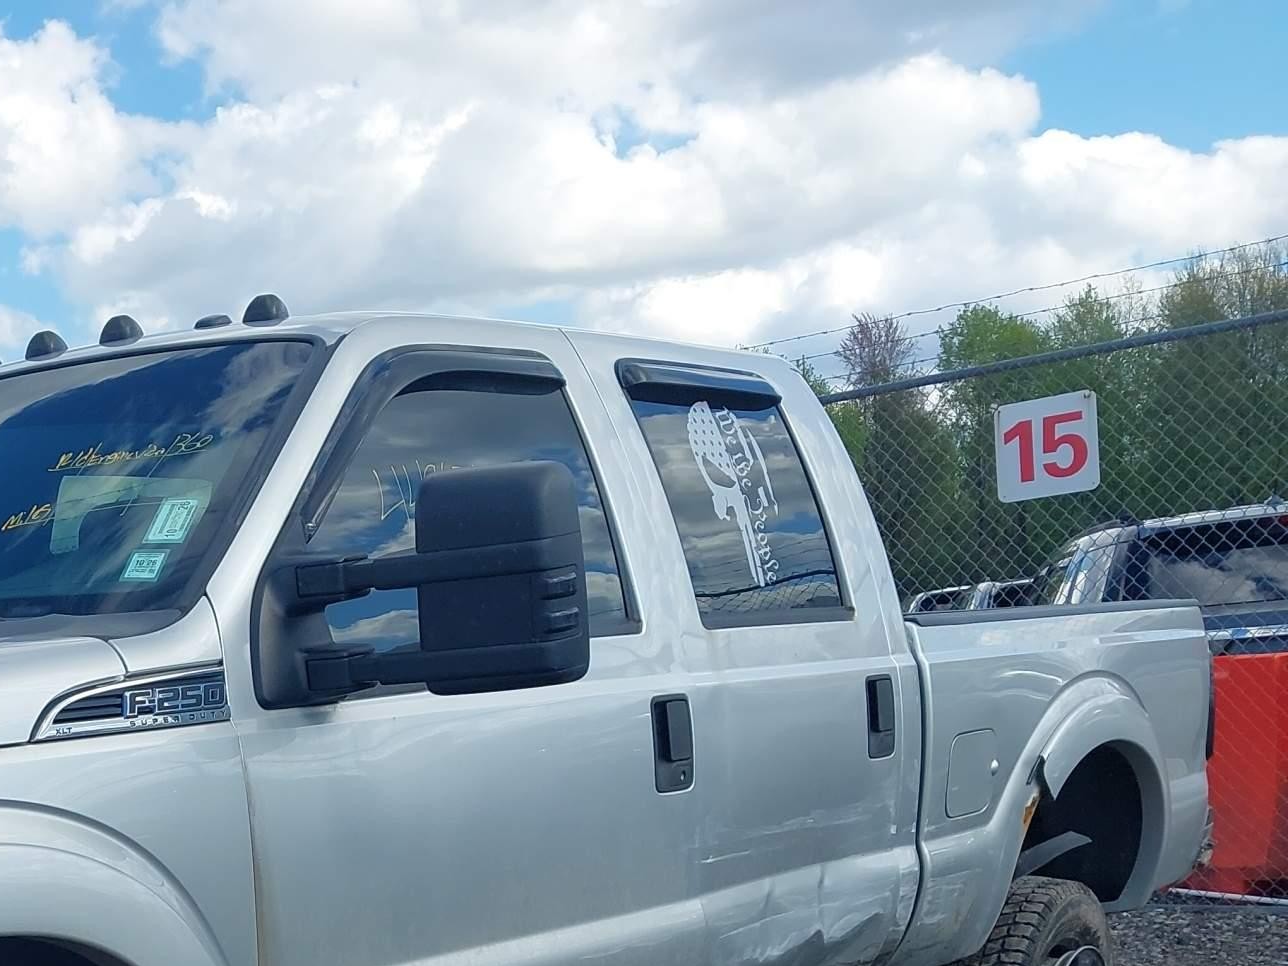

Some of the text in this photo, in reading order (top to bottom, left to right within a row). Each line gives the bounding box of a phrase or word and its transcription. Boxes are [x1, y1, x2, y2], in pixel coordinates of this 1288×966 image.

[715, 406, 737, 447] We
[1003, 410, 1089, 484] 15
[164, 528, 178, 538] 10
[124, 682, 227, 717] F-250
[55, 726, 73, 736] XLT
[129, 709, 228, 728] SUPER DUTY
